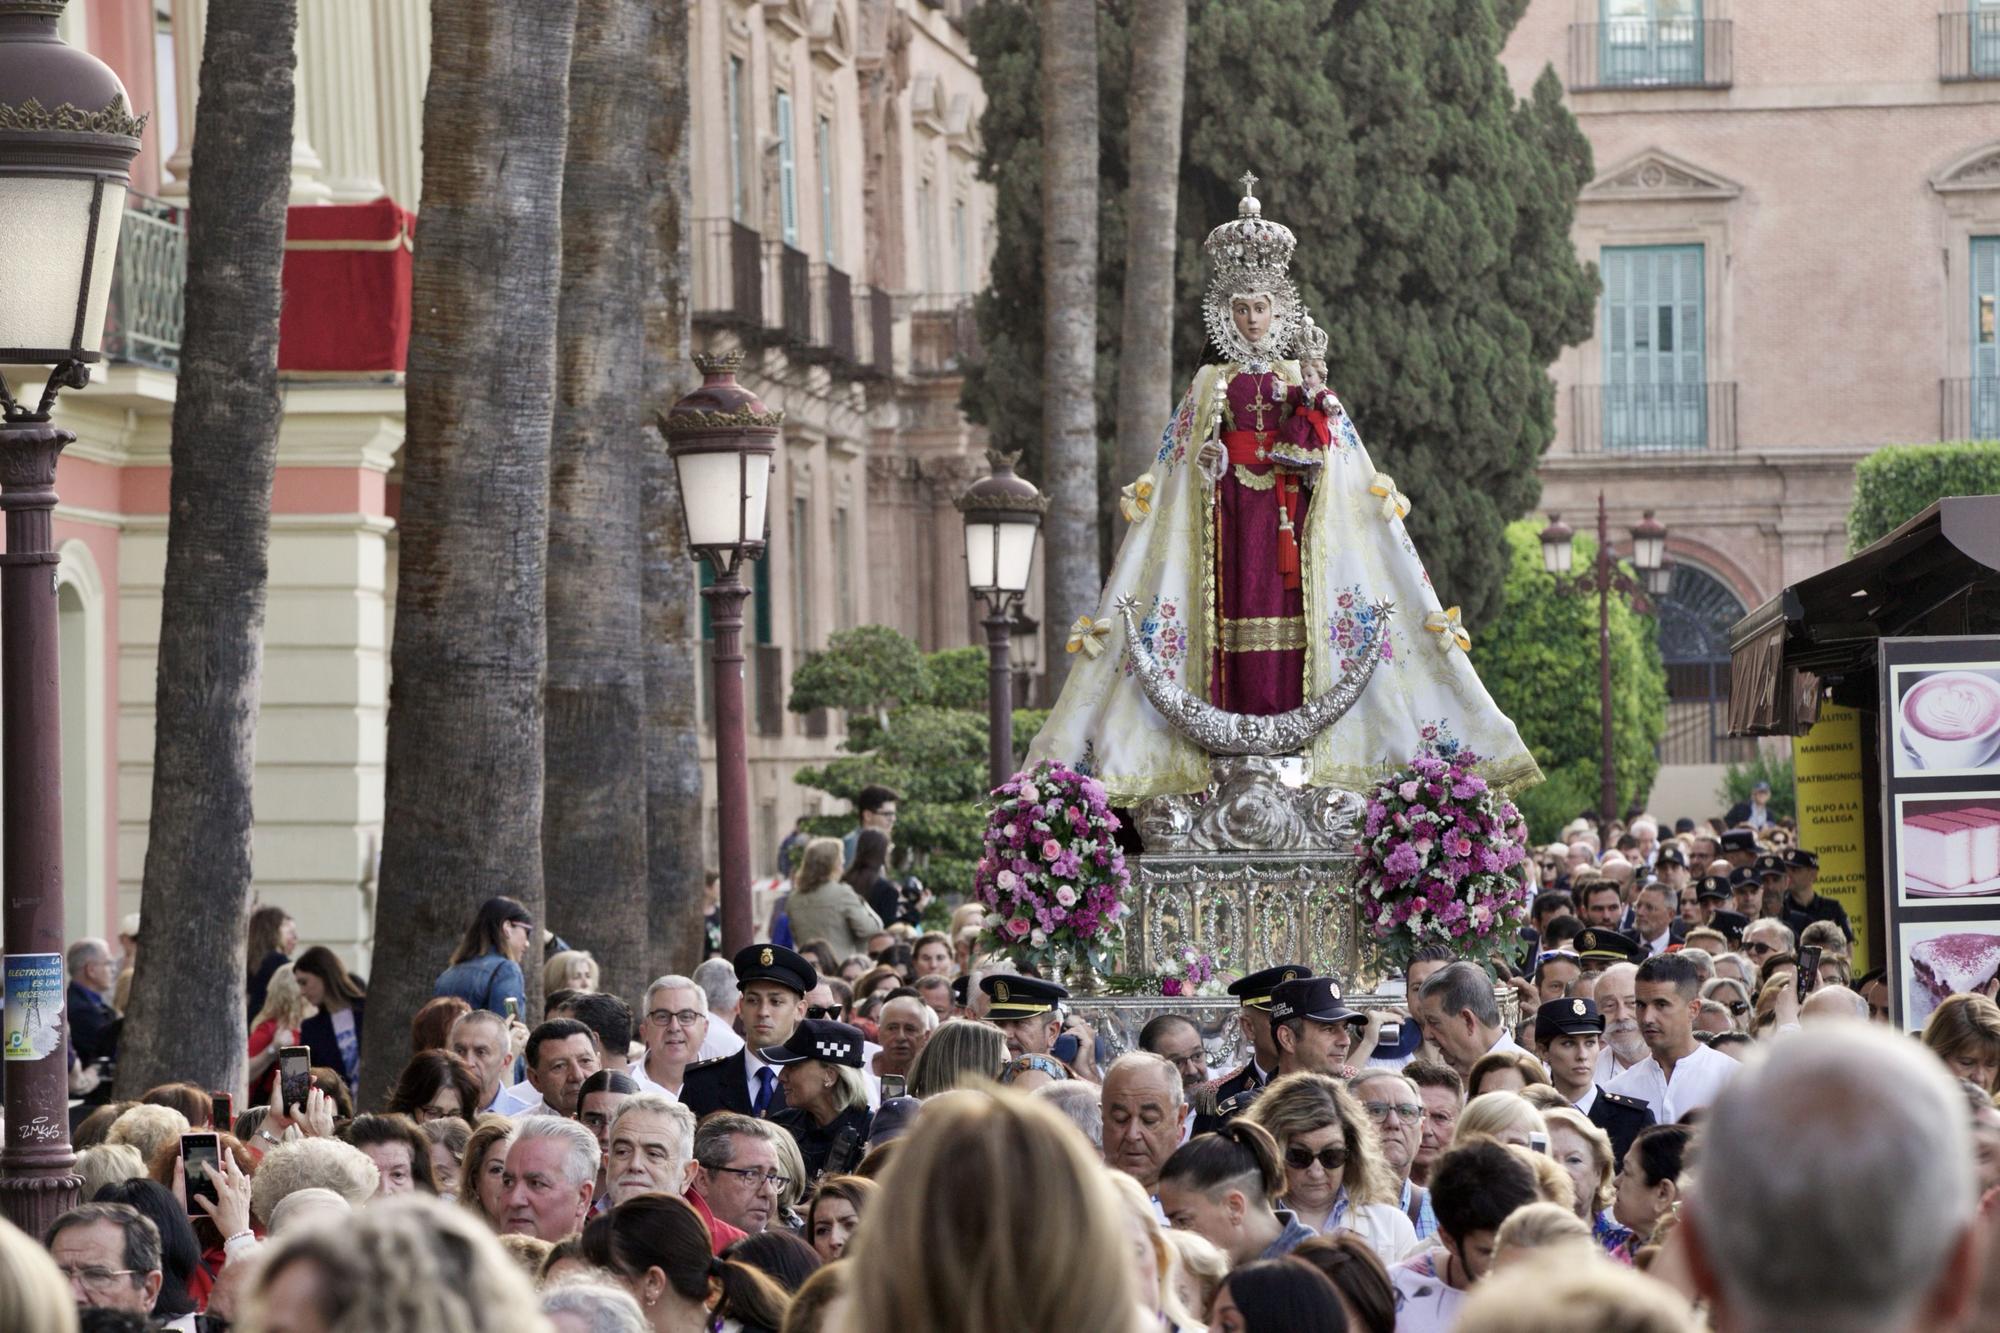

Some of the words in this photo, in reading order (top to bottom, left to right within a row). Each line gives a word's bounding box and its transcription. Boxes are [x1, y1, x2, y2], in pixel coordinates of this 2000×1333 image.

[1801, 743, 1853, 753] MARINERAS
[1798, 772, 1862, 783] MATRIMONIOS
[1806, 804, 1836, 813] PULPO
[1838, 802, 1846, 811] A
[1847, 802, 1858, 811] LA
[1812, 814, 1854, 824] GALLEGA
[1815, 844, 1856, 853] TORTILLA
[1814, 874, 1844, 883] AGRA
[1846, 872, 1865, 882] CON
[1821, 885, 1857, 895] TOMATE
[8, 968, 61, 977] ELECTRICIDAD
[32, 979, 44, 987] ES
[46, 978, 61, 987] UNA
